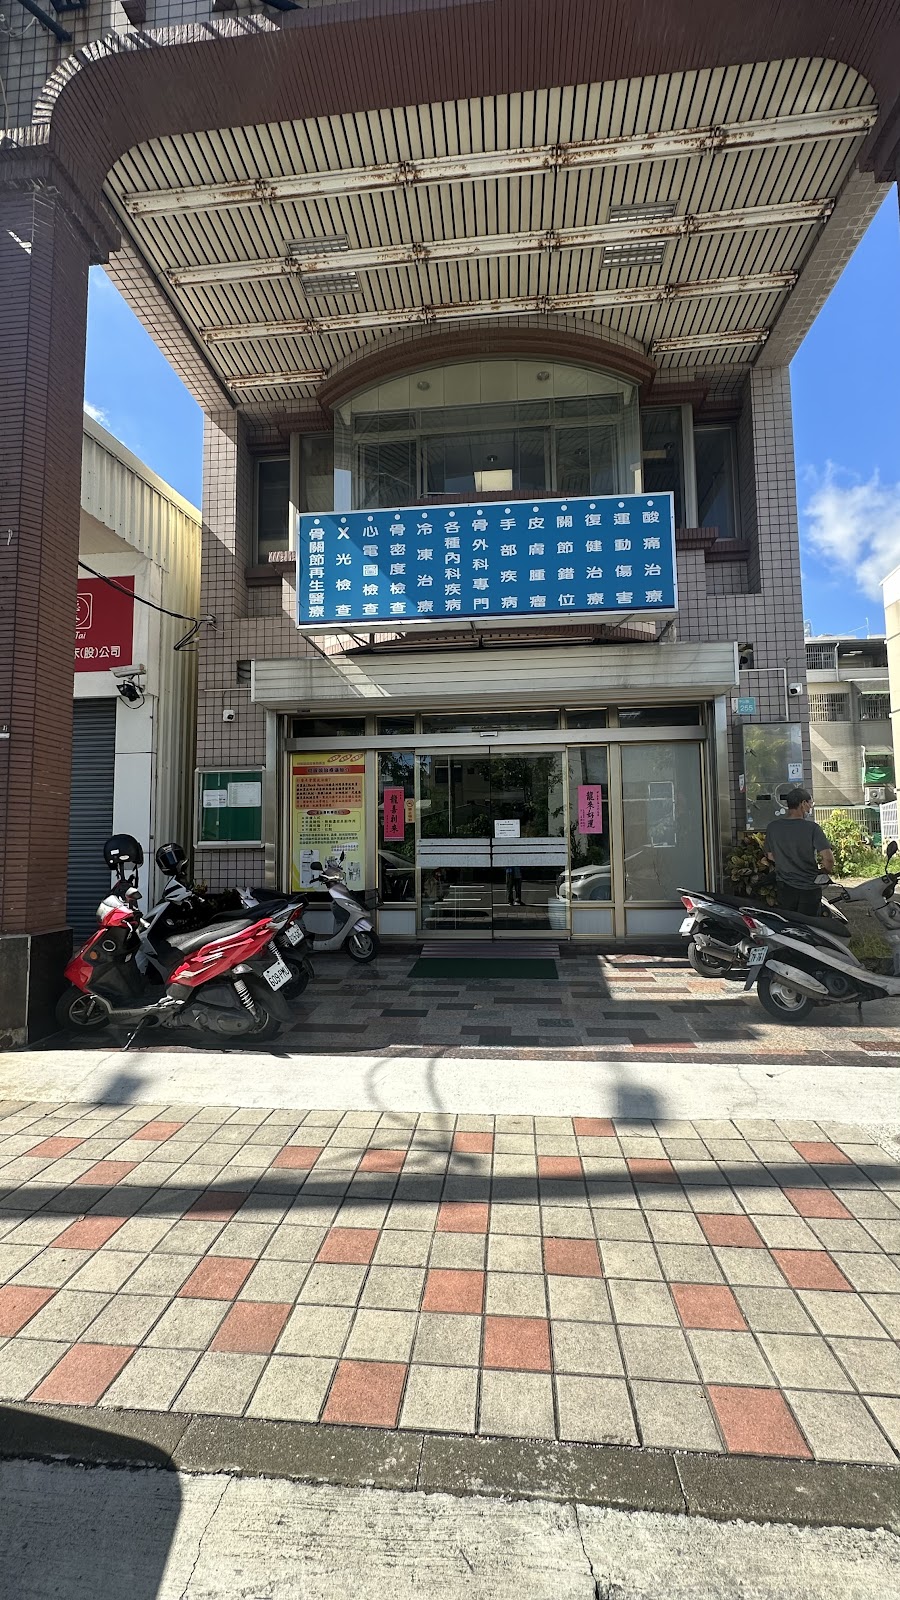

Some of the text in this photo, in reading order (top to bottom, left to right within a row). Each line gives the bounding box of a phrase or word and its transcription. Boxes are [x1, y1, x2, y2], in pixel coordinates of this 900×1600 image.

[309, 527, 325, 618] 骨關節再生醫療
[335, 526, 352, 617] X光檢查
[362, 525, 379, 616] 心電圖檢查
[389, 523, 406, 615] 骨密度檢查
[416, 522, 434, 613] 冷凍治療
[444, 521, 462, 612] 各種內科疾病
[472, 518, 490, 611] 骨外科專門
[500, 518, 518, 609] 手部疾病
[528, 516, 547, 608] 皮膚腫瘤
[556, 515, 575, 607] 關節錯位
[584, 513, 604, 605] 復健治療
[613, 512, 633, 605] 運動傷害
[642, 511, 663, 603] 酸痛治療
